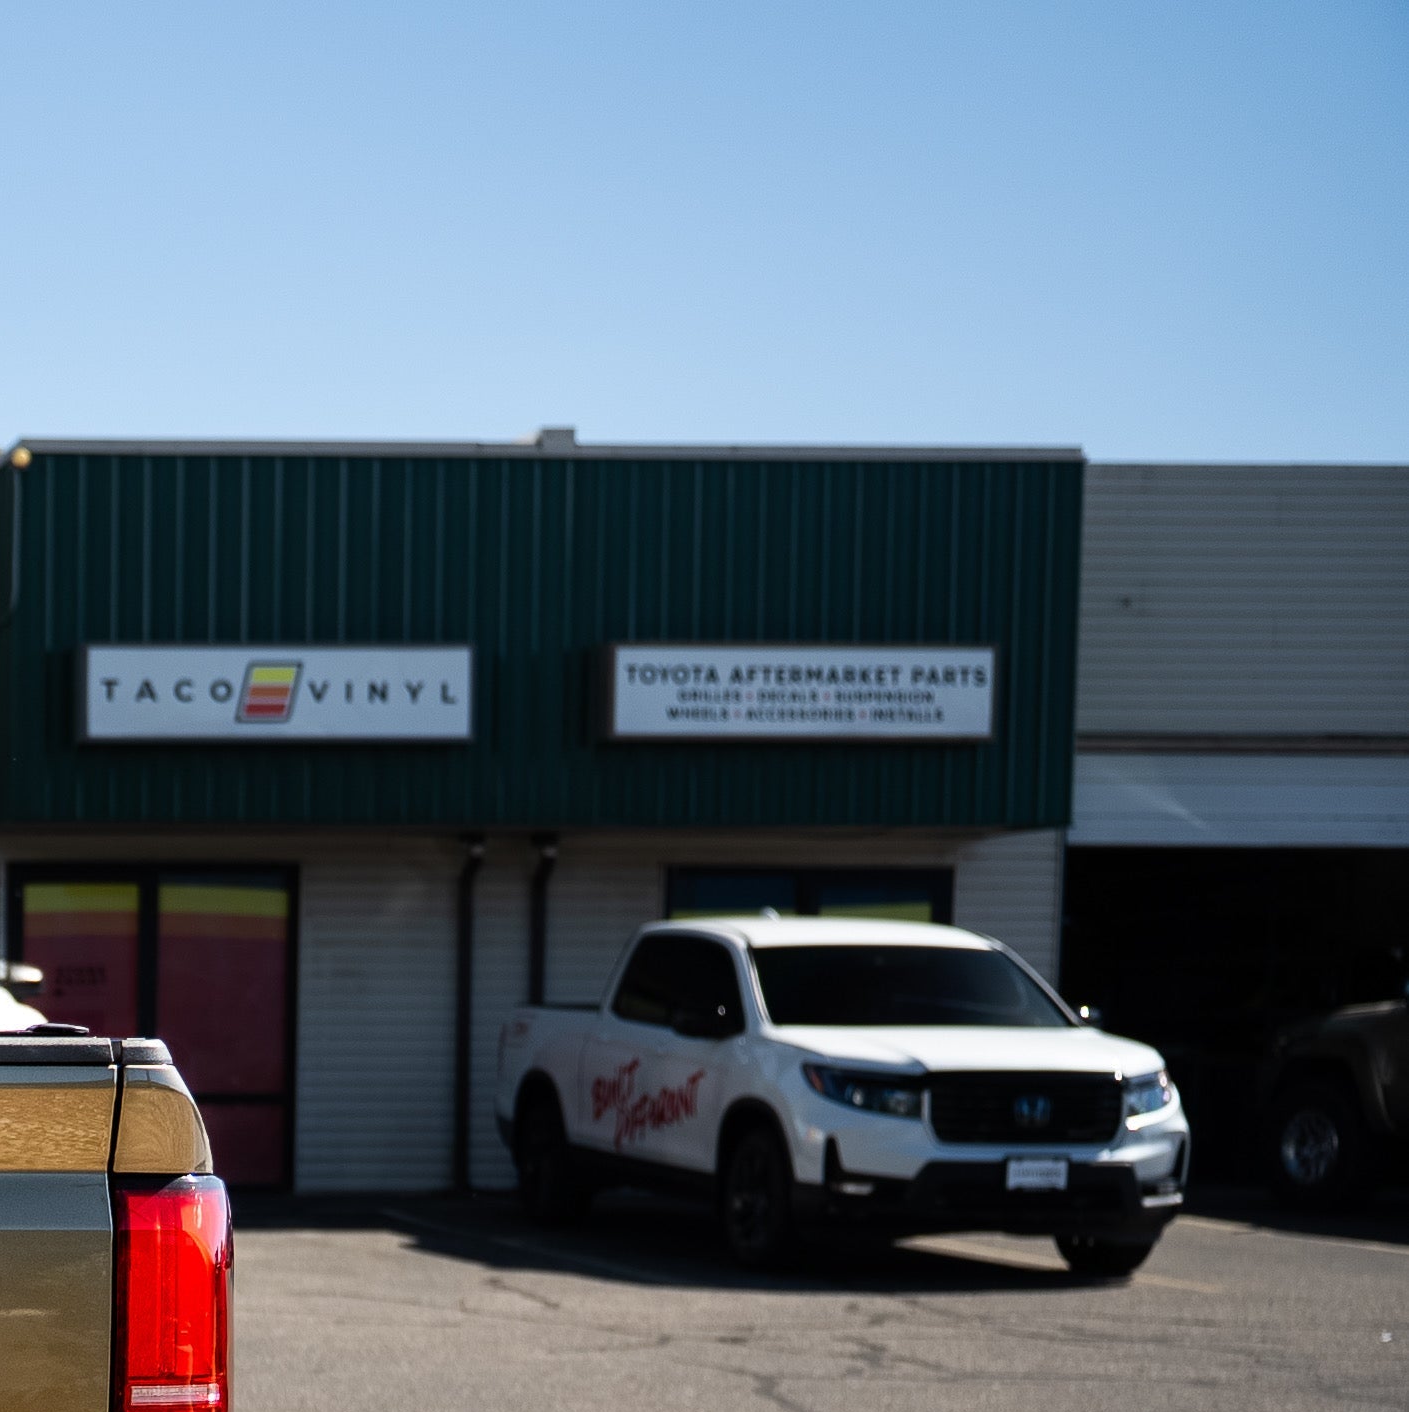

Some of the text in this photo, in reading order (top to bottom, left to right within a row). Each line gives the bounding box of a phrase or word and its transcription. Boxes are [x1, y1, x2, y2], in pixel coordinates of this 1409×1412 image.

[625, 663, 986, 688] TOYOTA AFTERMARKET PARTS
[101, 678, 458, 704] TACO VINYL
